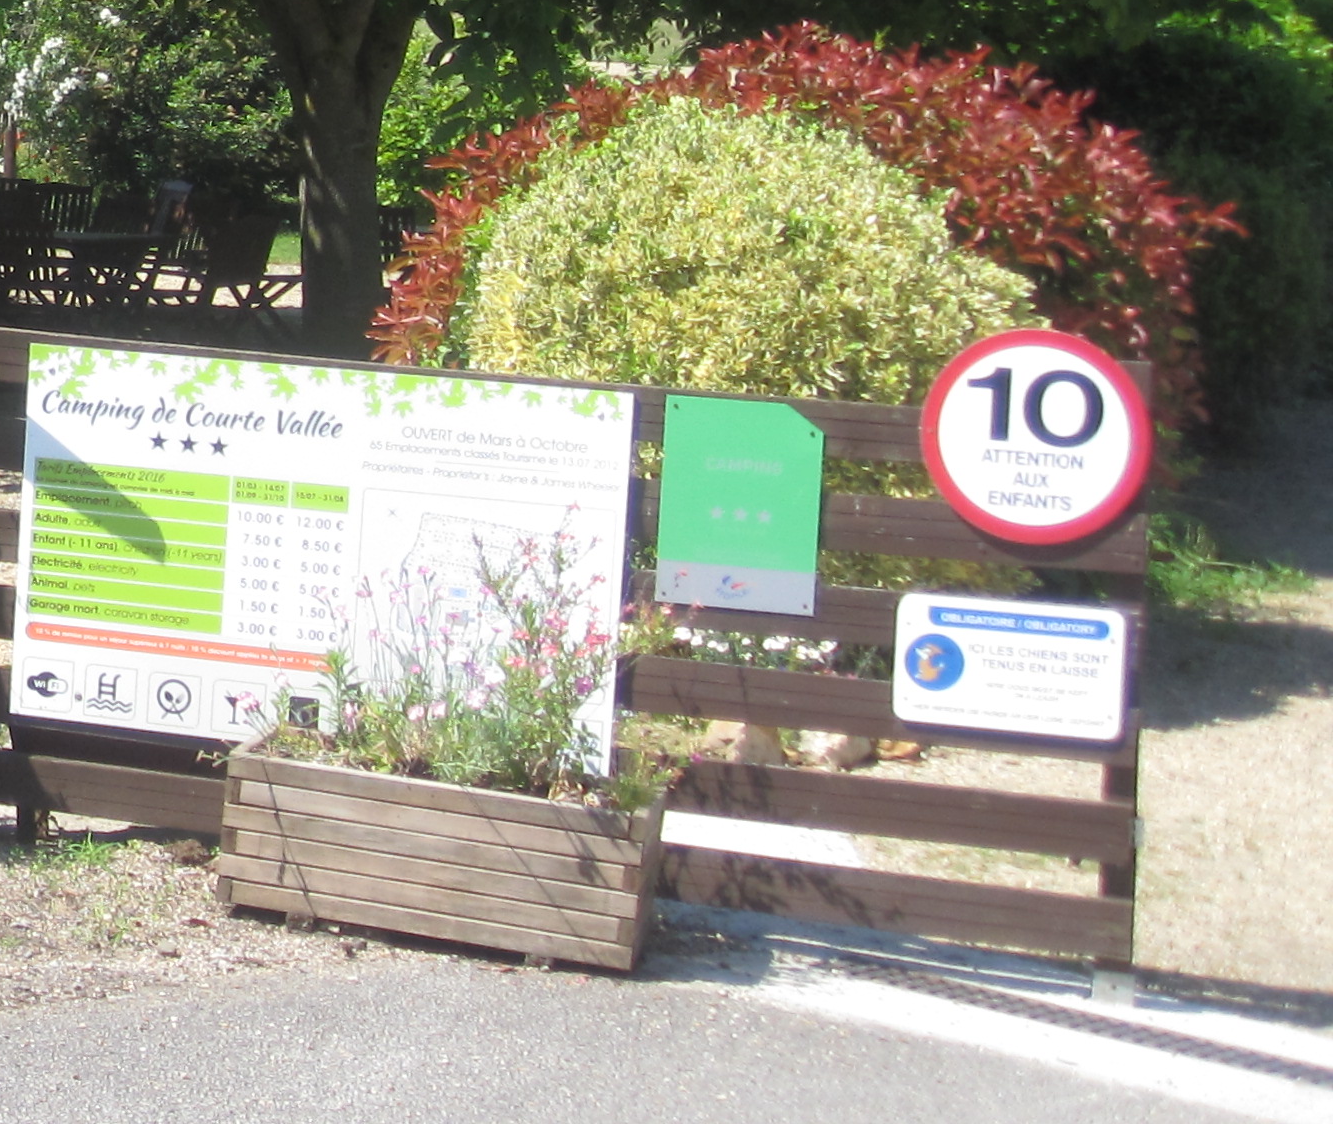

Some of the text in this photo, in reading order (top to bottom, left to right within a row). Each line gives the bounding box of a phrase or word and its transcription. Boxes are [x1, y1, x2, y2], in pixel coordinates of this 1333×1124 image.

[41, 389, 344, 439] Camping de Courte Vallée
[967, 367, 1104, 448] 10
[401, 426, 588, 454] OUVERT de Mars à Octobre
[385, 441, 462, 457] Emplacements
[464, 449, 500, 461] classés
[503, 451, 547, 465] Tourisme
[549, 456, 558, 465] le
[981, 449, 1084, 470] ATTENTION
[138, 470, 166, 483] 2016
[1013, 472, 1050, 488] AUX
[988, 490, 1073, 512] ENFANTS
[238, 510, 285, 525] 10.00 €
[297, 516, 344, 531] 12.00 €
[33, 532, 67, 545] Enfant
[191, 549, 223, 563] years)
[243, 533, 283, 548] 7.50 €
[301, 539, 343, 554] 8.50 €
[88, 562, 139, 576] electricity
[241, 556, 281, 570] 3.00 €
[300, 562, 341, 576] 5.00 €
[73, 582, 95, 593] pets
[240, 578, 280, 592] 5.00 €
[331, 587, 340, 598] €
[30, 598, 70, 613] Garage
[104, 608, 148, 620] caravan
[150, 611, 190, 626] storage
[240, 599, 278, 614] 1.50 €
[299, 606, 326, 619] 1.50
[237, 622, 277, 636] 3.00 €
[939, 612, 1017, 628] OBLIGATOIRE
[1023, 620, 1097, 634] OBLIGATORY
[296, 628, 337, 642] 3.00 €
[968, 644, 1109, 665] ICI LES CHIENS SONT
[982, 658, 1100, 678] TENUS EN LAISSE
